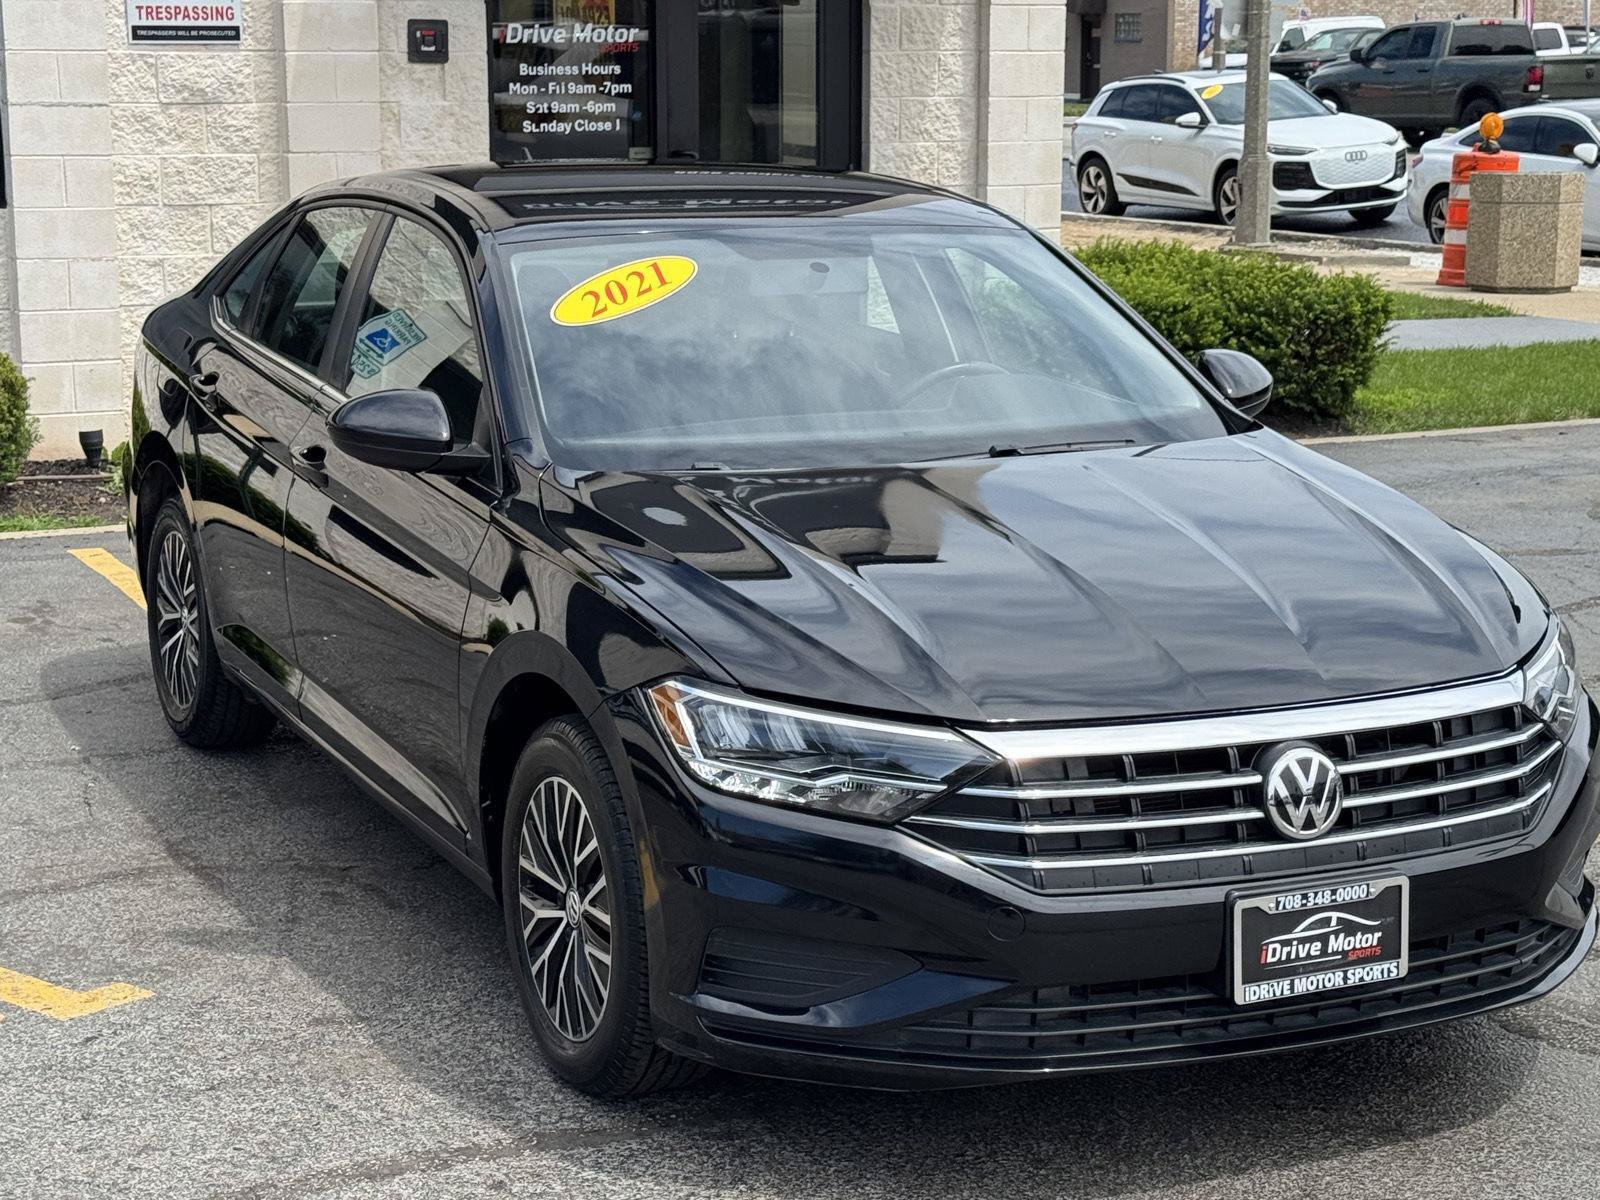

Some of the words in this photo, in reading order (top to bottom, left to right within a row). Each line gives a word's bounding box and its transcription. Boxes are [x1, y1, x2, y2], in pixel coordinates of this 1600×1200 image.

[135, 5, 235, 20] TRESPASSING
[572, 23, 640, 43] Motor
[519, 63, 579, 76] Business
[581, 62, 621, 75] Hours
[508, 82, 538, 95] Mon
[567, 82, 597, 94] 9am
[526, 101, 549, 114] Sat
[550, 101, 580, 114] 9am
[522, 120, 572, 135] Sunday
[581, 262, 672, 318] 2021
[1277, 884, 1368, 911] 708-348-0000
[1260, 939, 1322, 966] iDrive
[1327, 931, 1383, 954] Motor
[1347, 947, 1383, 961] SPORTS
[1293, 971, 1345, 994] MOTOR
[1346, 962, 1399, 985] SPORTS
